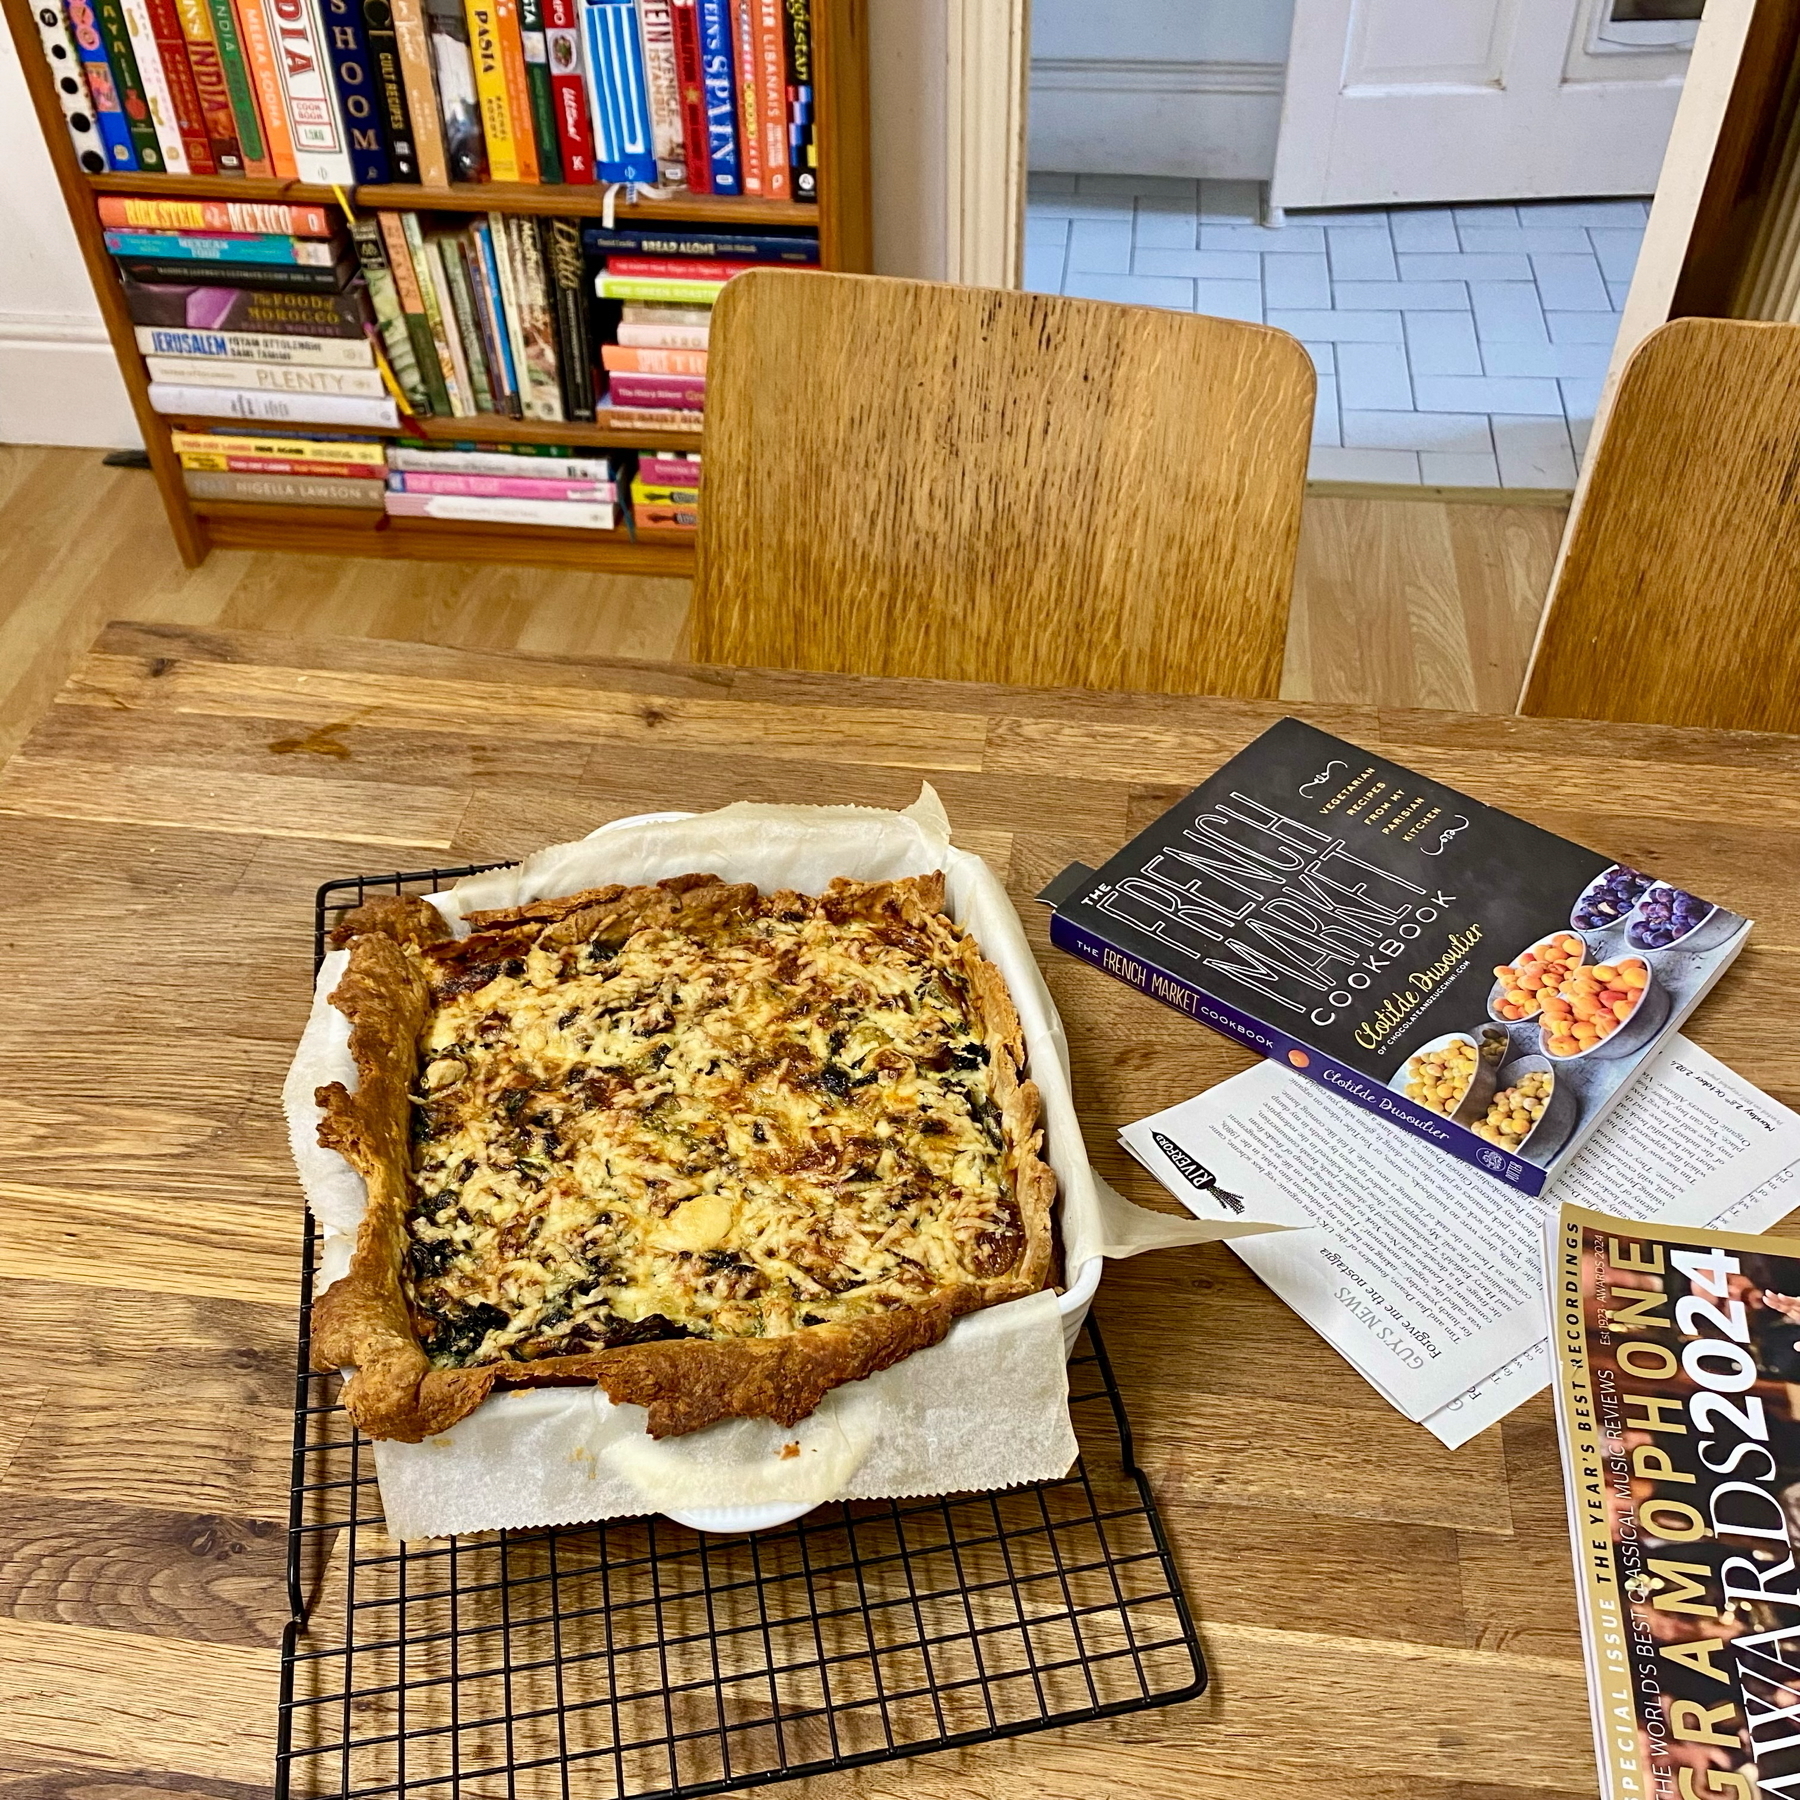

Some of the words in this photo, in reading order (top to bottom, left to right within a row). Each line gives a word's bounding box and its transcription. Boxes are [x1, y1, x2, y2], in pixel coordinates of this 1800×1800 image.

[474, 9, 496, 74] PASTA
[785, 0, 811, 82] giestan
[379, 51, 396, 81] CULT
[763, 33, 781, 118] LIBANAIS
[259, 68, 282, 129] SODHA
[384, 81, 404, 131] RECIPES
[702, 53, 735, 165] SPAIN
[156, 199, 207, 230] STEIN
[224, 200, 295, 236] MEXICO
[546, 215, 589, 291] Delia
[641, 240, 678, 253] BREAD
[678, 242, 716, 255] ALONE
[150, 330, 229, 357] JERUSALEM
[254, 368, 344, 394] PLENTY
[298, 483, 362, 500] LAWSON
[1318, 767, 1375, 813] VEGETARIAN
[1346, 782, 1385, 815] RECIPES
[1363, 802, 1391, 825] FROM
[1389, 789, 1404, 801] MY
[1381, 797, 1424, 834] PARISIAN
[1402, 807, 1441, 841] KITCHEN
[1096, 791, 1332, 959] FRENCH
[1081, 882, 1112, 907] THE
[1203, 839, 1427, 1013] MARKET
[1310, 889, 1457, 1026] COOKBOOK
[1354, 992, 1419, 1049] Clotilde
[1408, 924, 1482, 998] Dusoulier
[1377, 1045, 1386, 1054] OF
[1387, 953, 1469, 1044] CHOCOLATEANDZUCCHINI.COM
[1076, 940, 1098, 957] THE
[1103, 947, 1146, 987] FRENCH
[1151, 973, 1199, 1013] MARKET
[1200, 1006, 1273, 1048] COOKBOOK
[1323, 1069, 1376, 1102] Clotilde
[1378, 1097, 1449, 1139] Dusoulier
[1670, 1060, 1693, 1076] 2024
[1694, 1076, 1725, 1097] October
[1208, 1125, 1226, 1139] came
[1221, 1120, 1240, 1139] 1980s,
[1227, 1113, 1269, 1148] management
[1743, 1108, 1775, 1131] Monday
[1227, 1139, 1252, 1160] scheme,
[1240, 1139, 1252, 1148] the
[1155, 1134, 1213, 1187] RIVERFORD
[1252, 1160, 1265, 1173] box
[1260, 1153, 1278, 1169] what,
[1278, 1169, 1292, 1182] into
[1281, 1159, 1293, 1169] life
[1263, 1170, 1276, 1182] veg
[1302, 1176, 1319, 1192] back
[1276, 1183, 1302, 1204] organic
[1292, 1181, 1324, 1209] induction
[1301, 1204, 1316, 1217] first
[1316, 1216, 1334, 1233] UK's
[1328, 1200, 1355, 1221] turned
[1335, 1233, 1347, 1243] the
[1344, 1226, 1362, 1242] back
[1359, 1228, 1401, 1259] movement'.
[1594, 1234, 1605, 1264] 2024
[1319, 1247, 1367, 1286] nostalgia
[1358, 1250, 1389, 1277] founders
[1374, 1250, 1397, 1270] taking
[1400, 1260, 1429, 1285] 'organic
[1365, 1287, 1384, 1304] the
[1390, 1276, 1415, 1301] Deane,
[1403, 1276, 1439, 1306] yesterday
[1431, 1286, 1444, 1296] the
[1566, 1223, 1583, 1368] RECORDINGS
[1595, 1264, 1607, 1303] AWARDS
[1333, 1286, 1382, 1329] NEWS
[1384, 1304, 1403, 1320] me
[1415, 1300, 1432, 1313] Jan
[1426, 1312, 1444, 1326] and
[1438, 1305, 1460, 1326] lunch
[1442, 1296, 1467, 1315] called
[1597, 1307, 1609, 1330] 1923
[1444, 1326, 1460, 1344] Tim
[1459, 1326, 1472, 1336] for
[1466, 1316, 1481, 1329] was
[1376, 1327, 1423, 1369] GUY'S
[1401, 1320, 1441, 1358] Forgive
[1599, 1331, 1611, 1346] Est
[1574, 1381, 1592, 1432] BEST
[1597, 1369, 1623, 1440] REVIEWS
[1586, 1444, 1604, 1524] YEAR'S
[1608, 1444, 1632, 1500] MUSIC
[1608, 1238, 1751, 1800] GRAMOPHONE
[1594, 1540, 1611, 1584] THE
[1618, 1506, 1647, 1605] CLASSICAL
[1602, 1598, 1625, 1673] ISSUE
[1630, 1608, 1654, 1658] BEST
[1639, 1664, 1670, 1757] WORLD'S
[1611, 1688, 1640, 1800] PECIAL
[1651, 1763, 1674, 1800] THE
